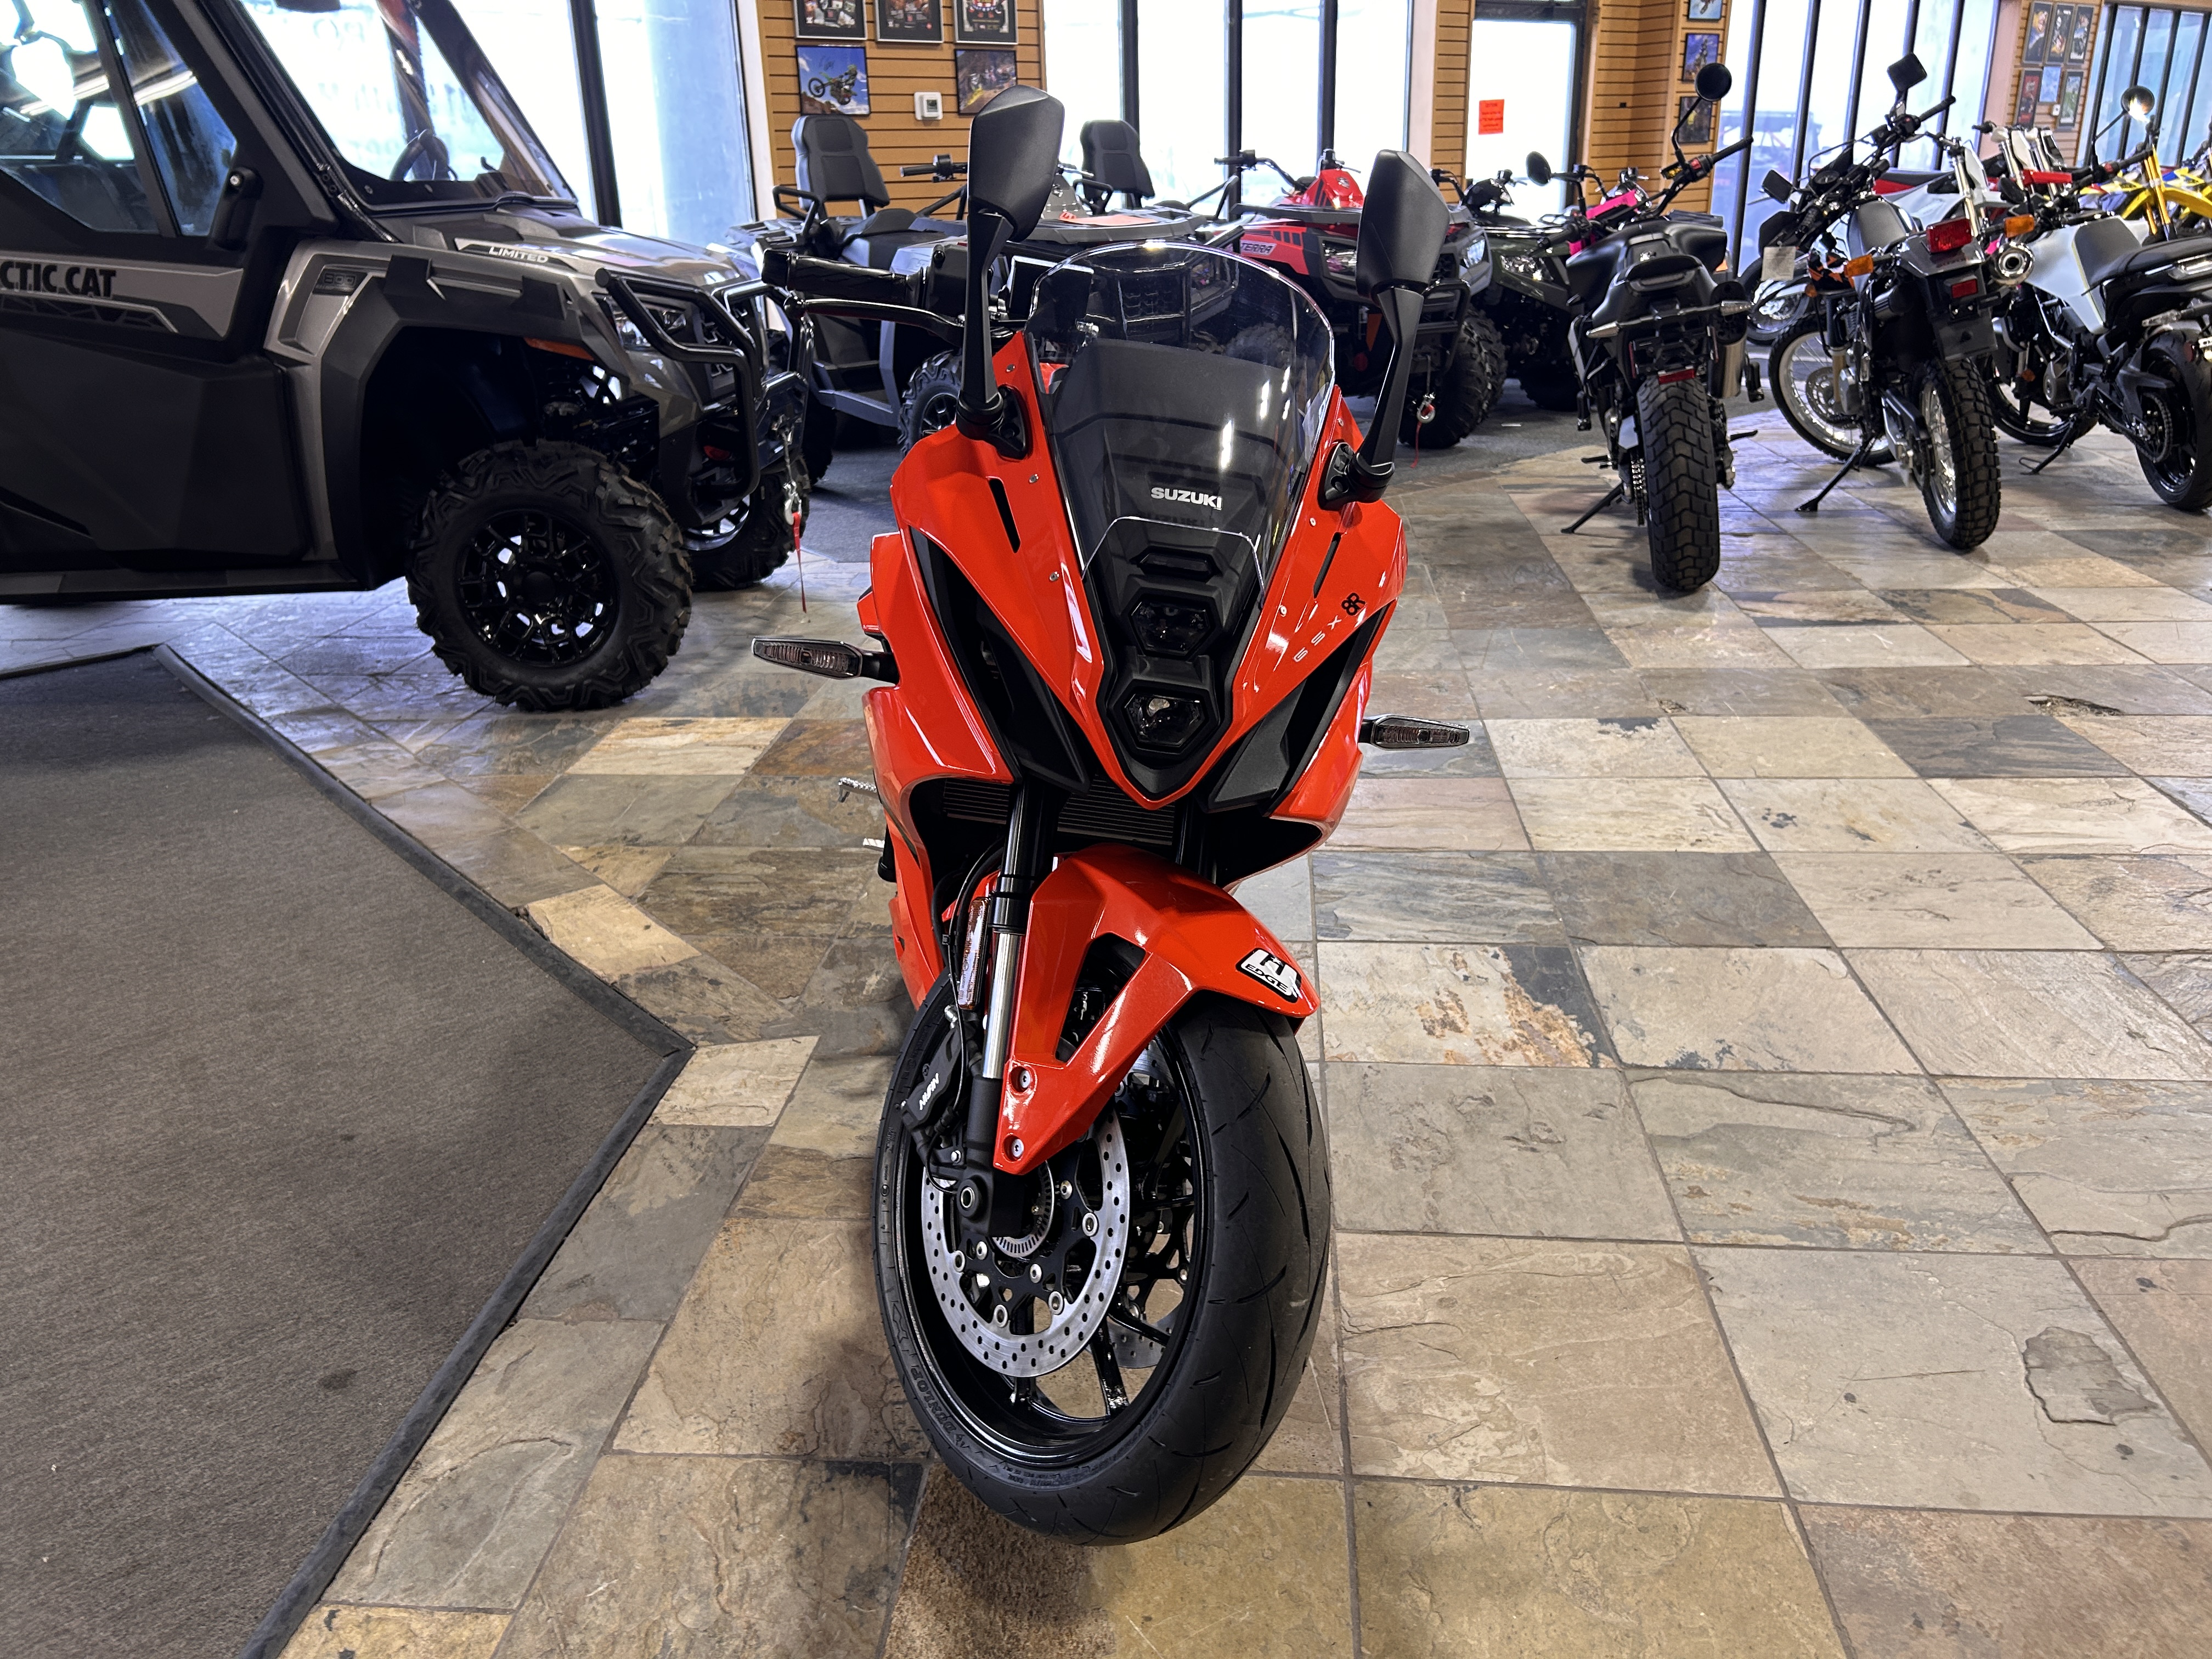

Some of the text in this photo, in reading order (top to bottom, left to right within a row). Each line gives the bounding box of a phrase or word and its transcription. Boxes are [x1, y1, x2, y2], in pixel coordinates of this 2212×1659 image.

[488, 246, 549, 263] LIMITED
[65, 267, 116, 297] CAT
[1150, 487, 1222, 510] SUZUKI
[1245, 963, 1289, 992] EDGE
[910, 1368, 957, 1435] DUNLOP
